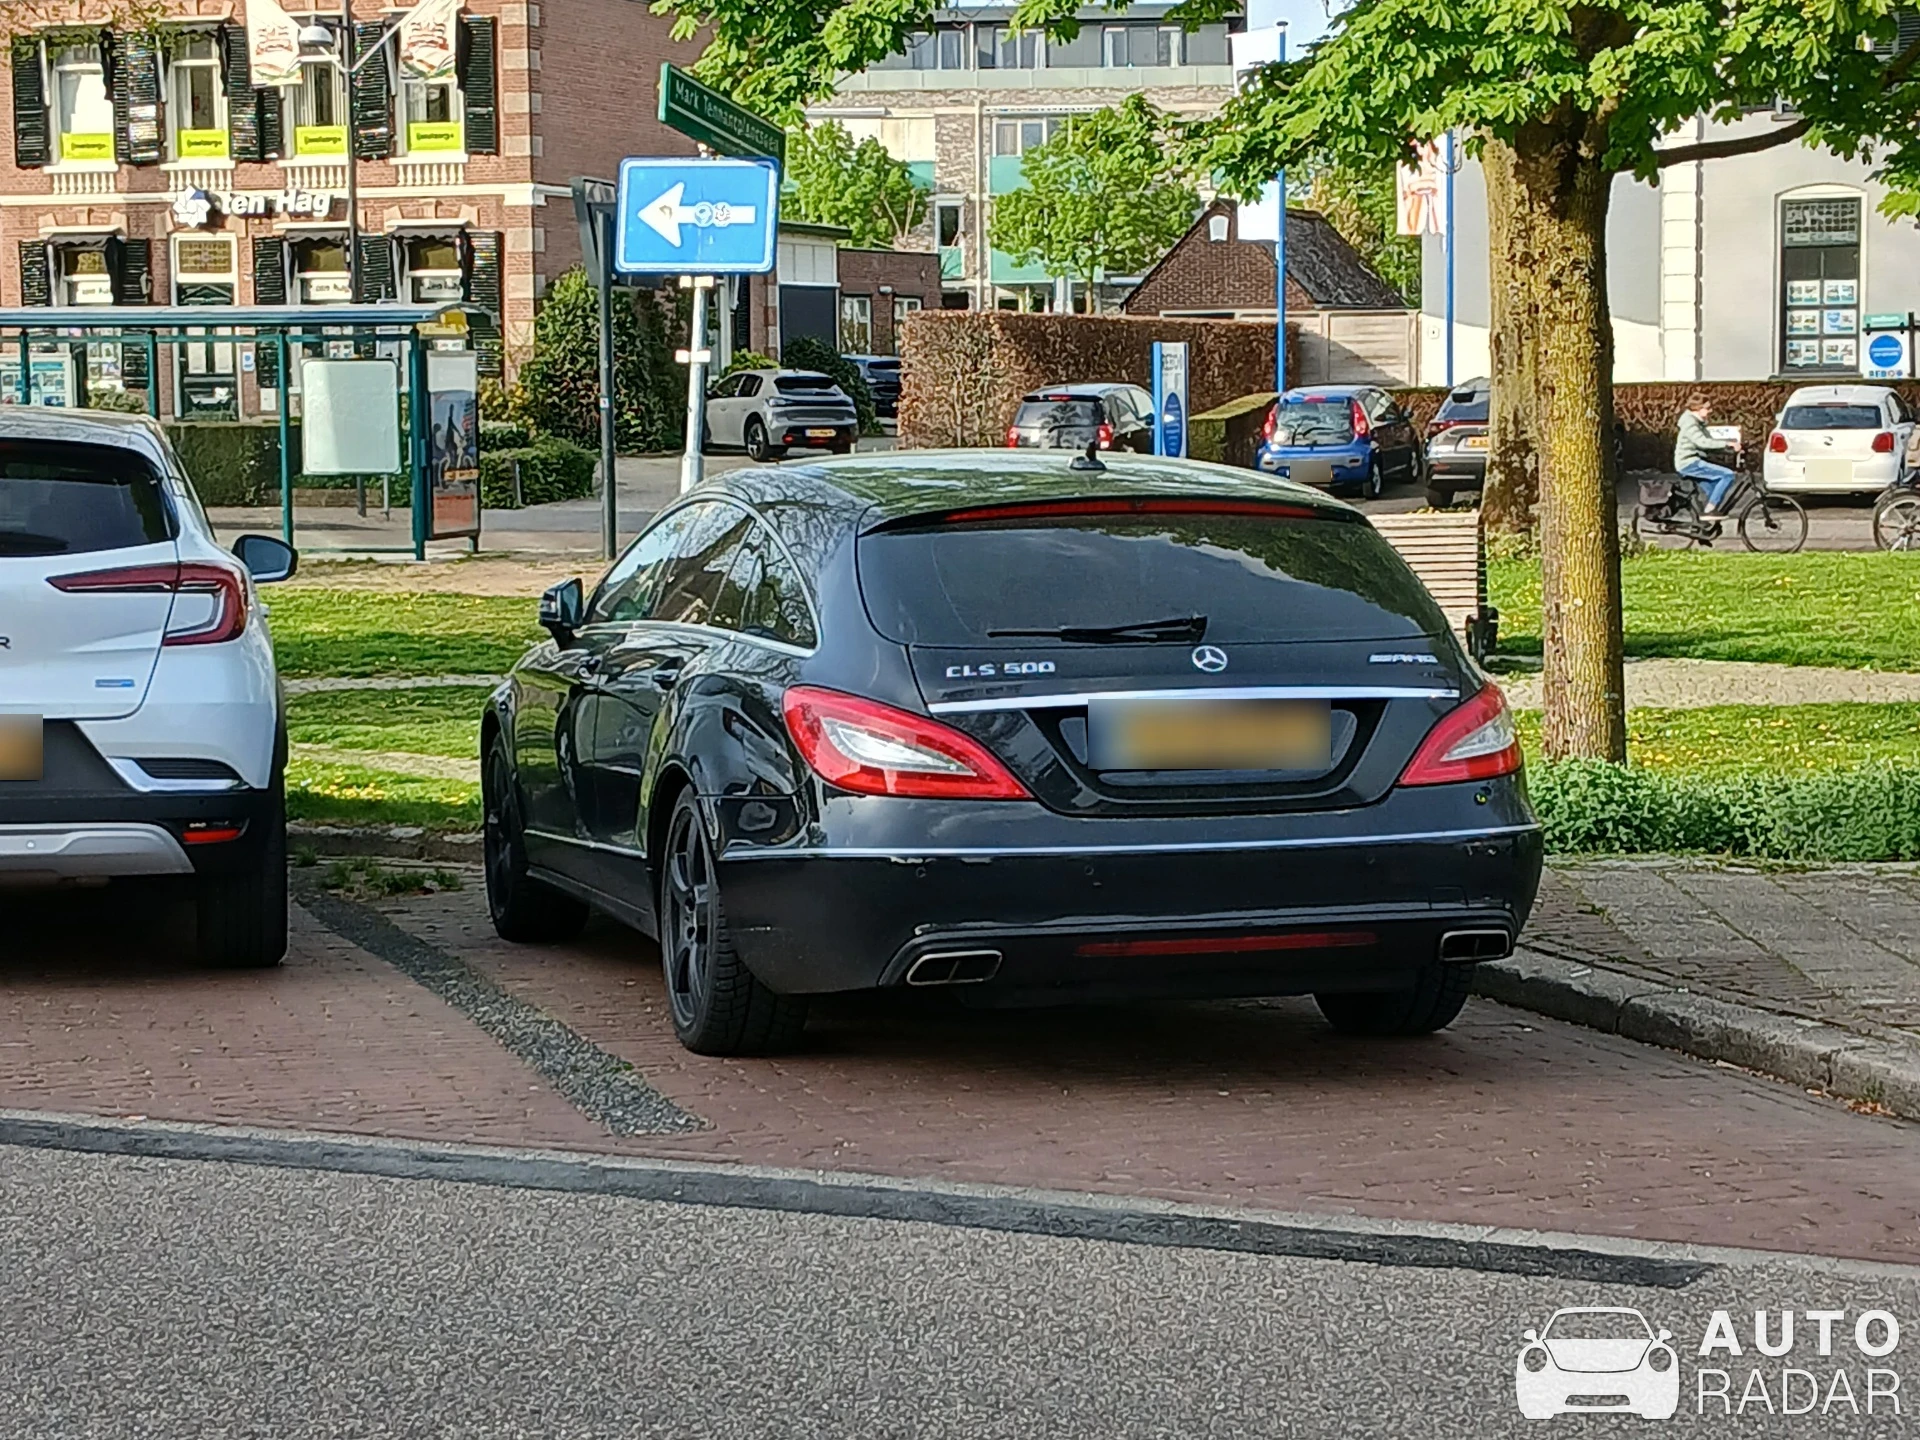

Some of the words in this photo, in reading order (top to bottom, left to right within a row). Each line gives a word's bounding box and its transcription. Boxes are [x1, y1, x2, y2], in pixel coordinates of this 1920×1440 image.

[675, 79, 699, 110] Mark
[220, 193, 266, 216] ten
[275, 188, 331, 218] Hag
[946, 663, 996, 678] CLS
[1003, 661, 1056, 675] 500
